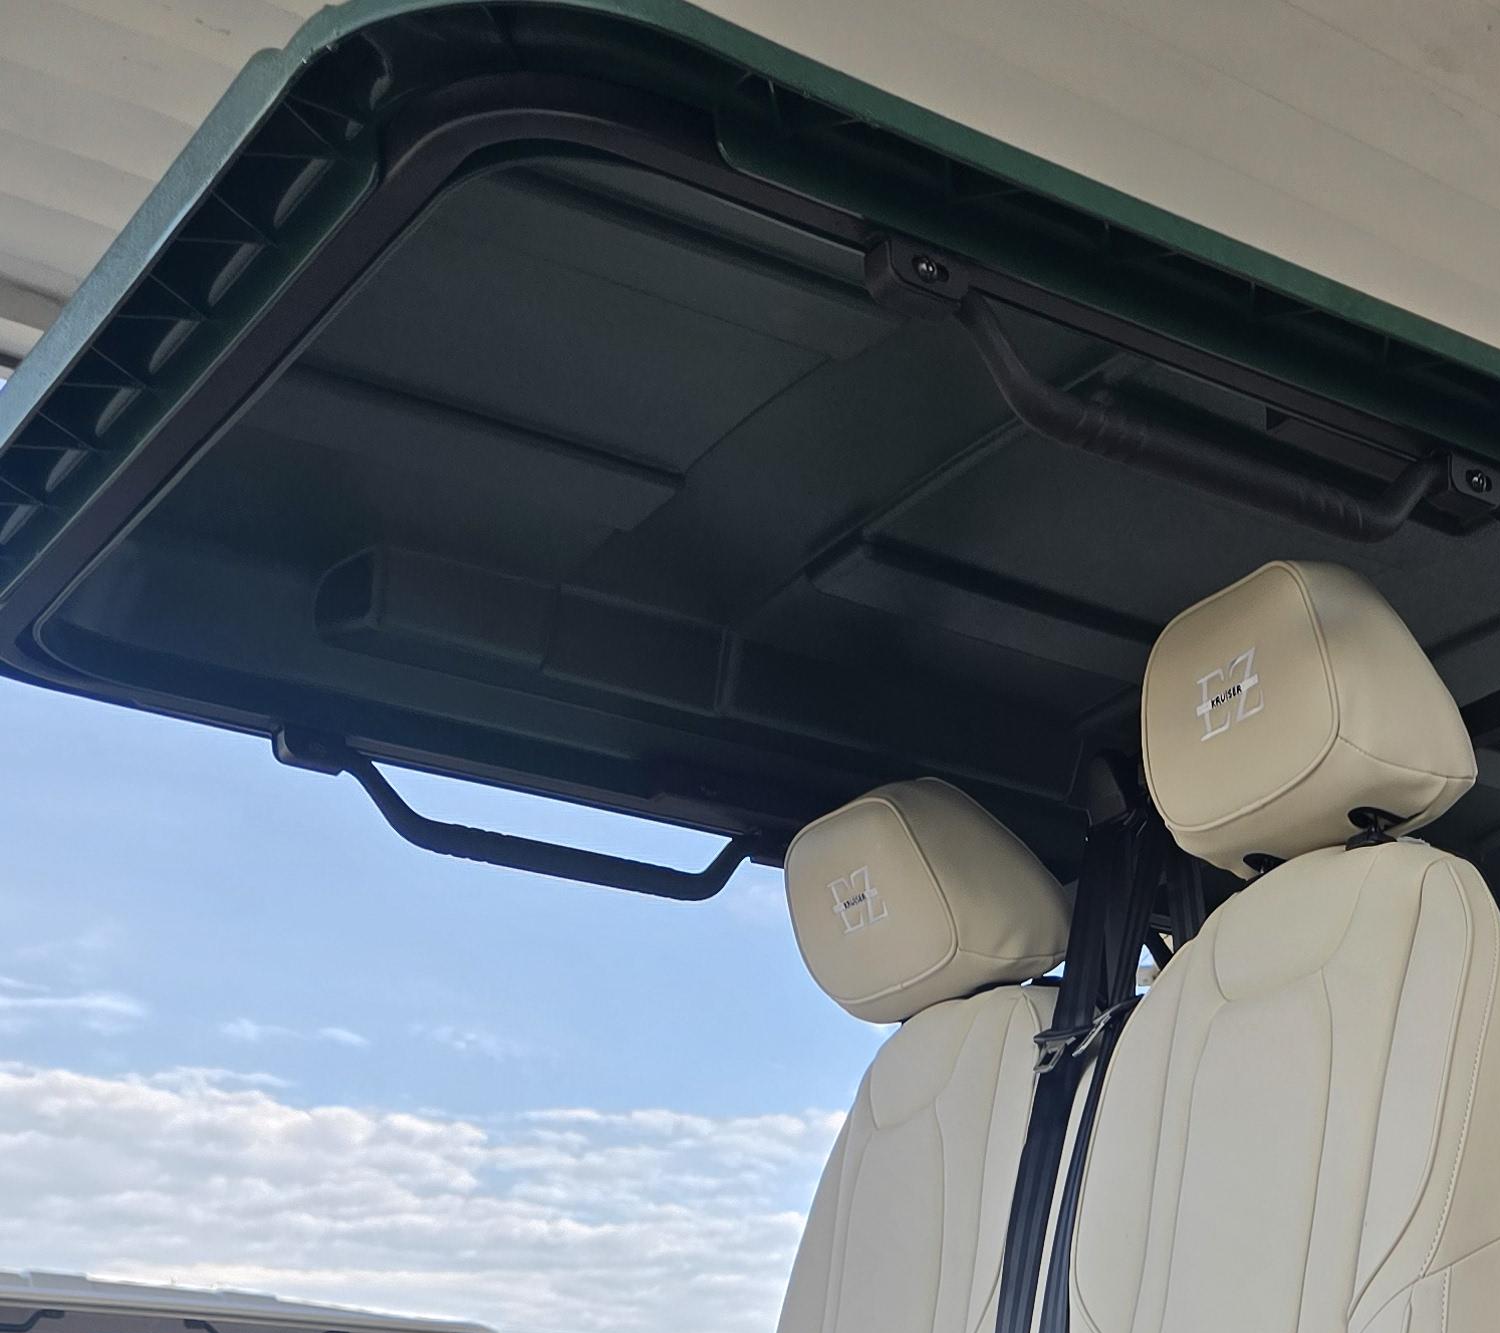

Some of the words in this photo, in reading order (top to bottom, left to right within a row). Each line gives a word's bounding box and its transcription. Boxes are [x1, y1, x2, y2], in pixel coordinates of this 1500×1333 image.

[1196, 646, 1264, 742] EZ
[1211, 684, 1243, 709] KRUISER
[826, 865, 888, 935] EZ
